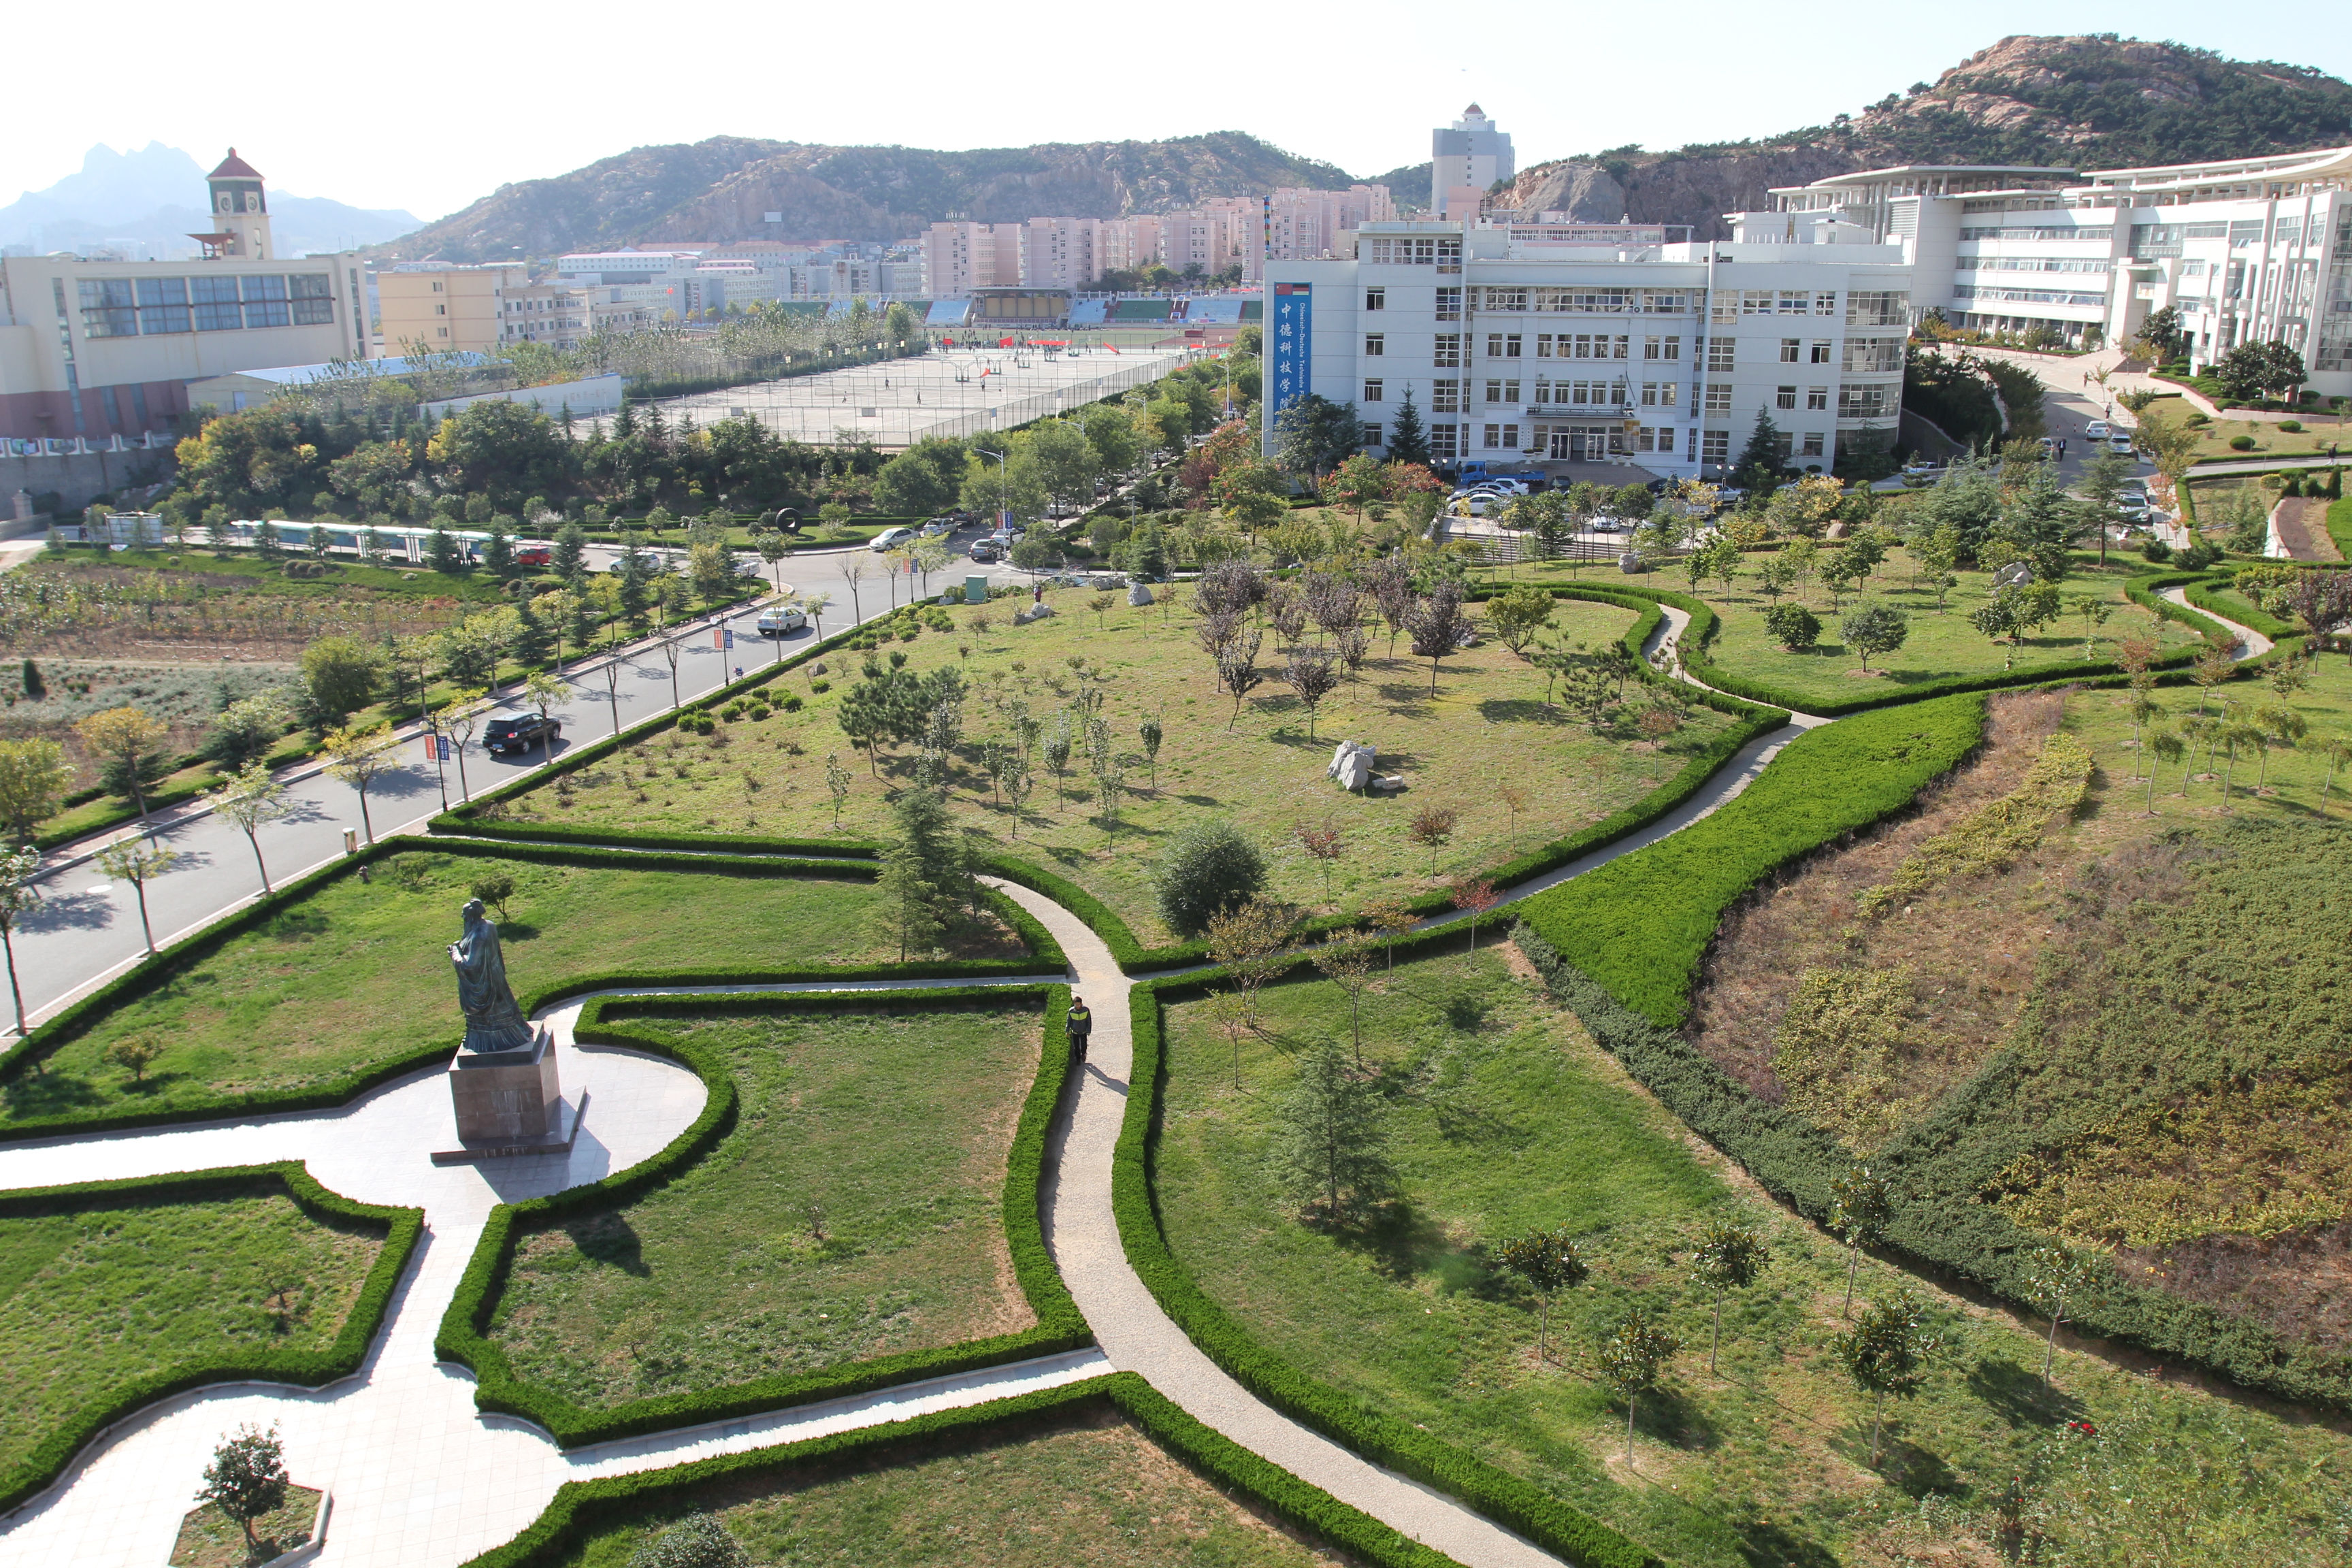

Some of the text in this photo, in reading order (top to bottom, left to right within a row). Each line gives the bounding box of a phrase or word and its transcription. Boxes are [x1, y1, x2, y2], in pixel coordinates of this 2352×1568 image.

[1279, 303, 1292, 410] 中德科技学院
